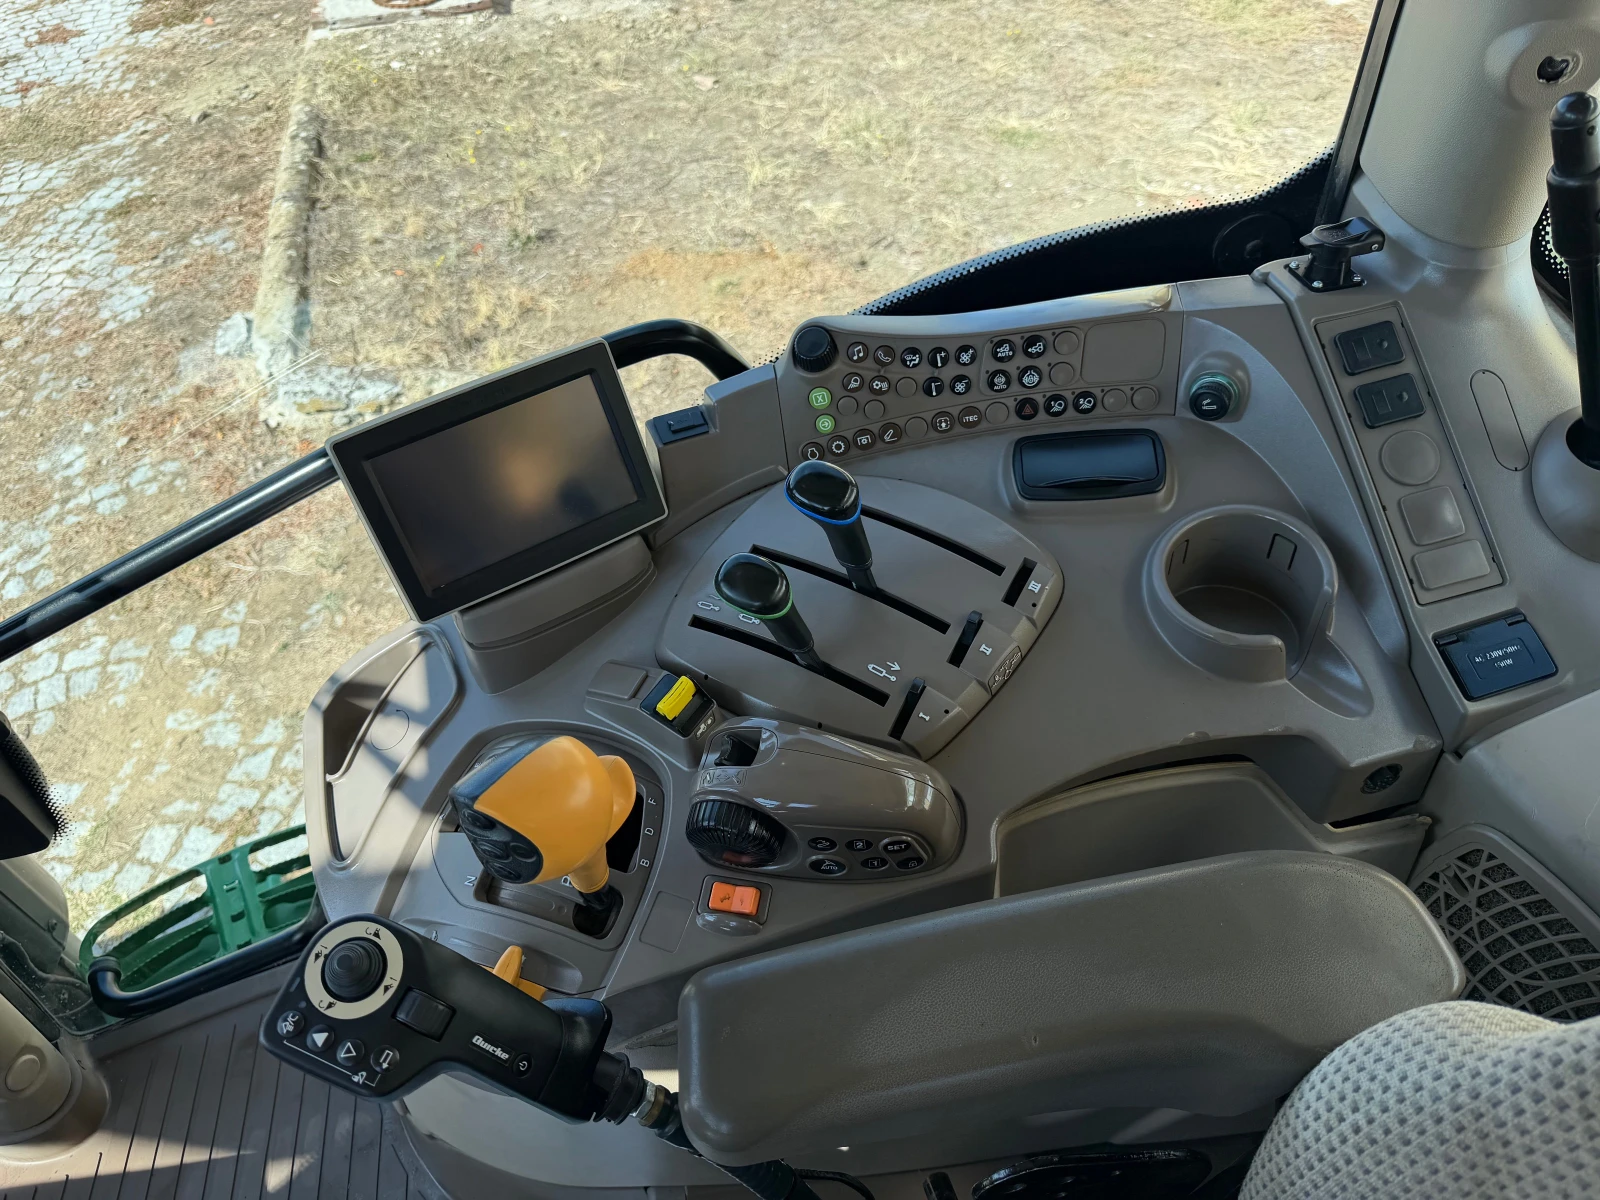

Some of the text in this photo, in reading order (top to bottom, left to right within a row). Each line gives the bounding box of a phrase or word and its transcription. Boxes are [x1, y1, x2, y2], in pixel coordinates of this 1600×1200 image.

[648, 797, 656, 805] F
[644, 827, 654, 836] D
[887, 843, 907, 851] SET
[639, 858, 650, 867] B
[464, 875, 477, 887] N
[472, 1034, 509, 1060] Quicke
